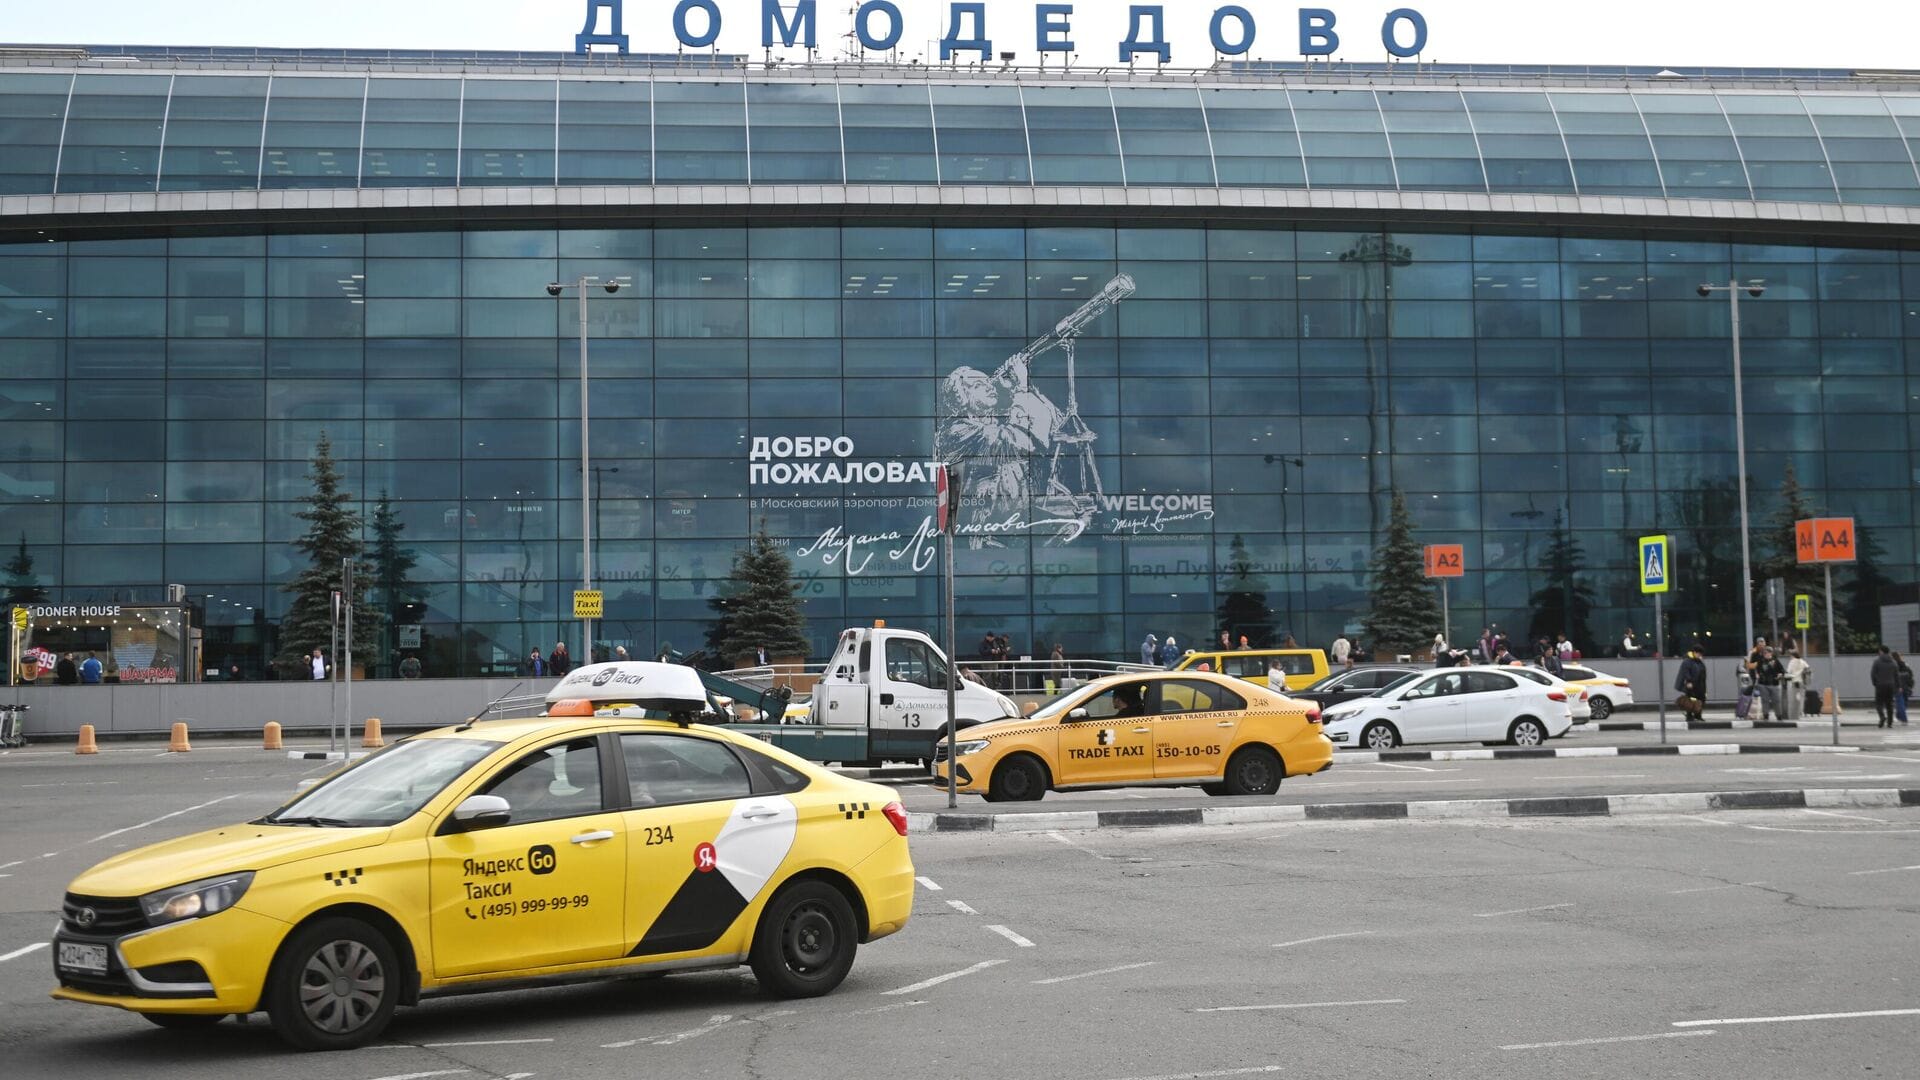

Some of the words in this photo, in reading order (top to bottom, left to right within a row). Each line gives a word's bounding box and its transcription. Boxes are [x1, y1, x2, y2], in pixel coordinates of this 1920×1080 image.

[575, 0, 1428, 63] ДОМОДЕДОВО
[750, 436, 854, 461] ДОБРО
[750, 462, 949, 484] ПОЖАЛОВАТ
[750, 499, 757, 508] в
[761, 497, 839, 509] Московский
[844, 498, 903, 511] аэропорт
[1102, 495, 1212, 511] WELCOME
[36, 606, 77, 617] DONER
[81, 605, 121, 616] HOUSE
[576, 600, 599, 608] Taxi
[38, 651, 57, 669] 99
[119, 666, 177, 681] ШАУРМА
[612, 670, 645, 685] Такси
[1252, 698, 1269, 707] 248
[902, 713, 921, 728] 13
[1160, 712, 1239, 721] WWW.TRADETAXI.RU
[1068, 747, 1111, 760] TRADE
[1114, 745, 1145, 757] TAXI
[1156, 744, 1221, 758] 150-10-05
[643, 825, 674, 846] 234
[463, 856, 525, 877] Яндекс
[530, 850, 554, 870] Go
[699, 847, 713, 868] Я
[463, 882, 512, 901] Такси
[481, 901, 517, 920] (495)
[521, 894, 589, 913] 999-99-99
